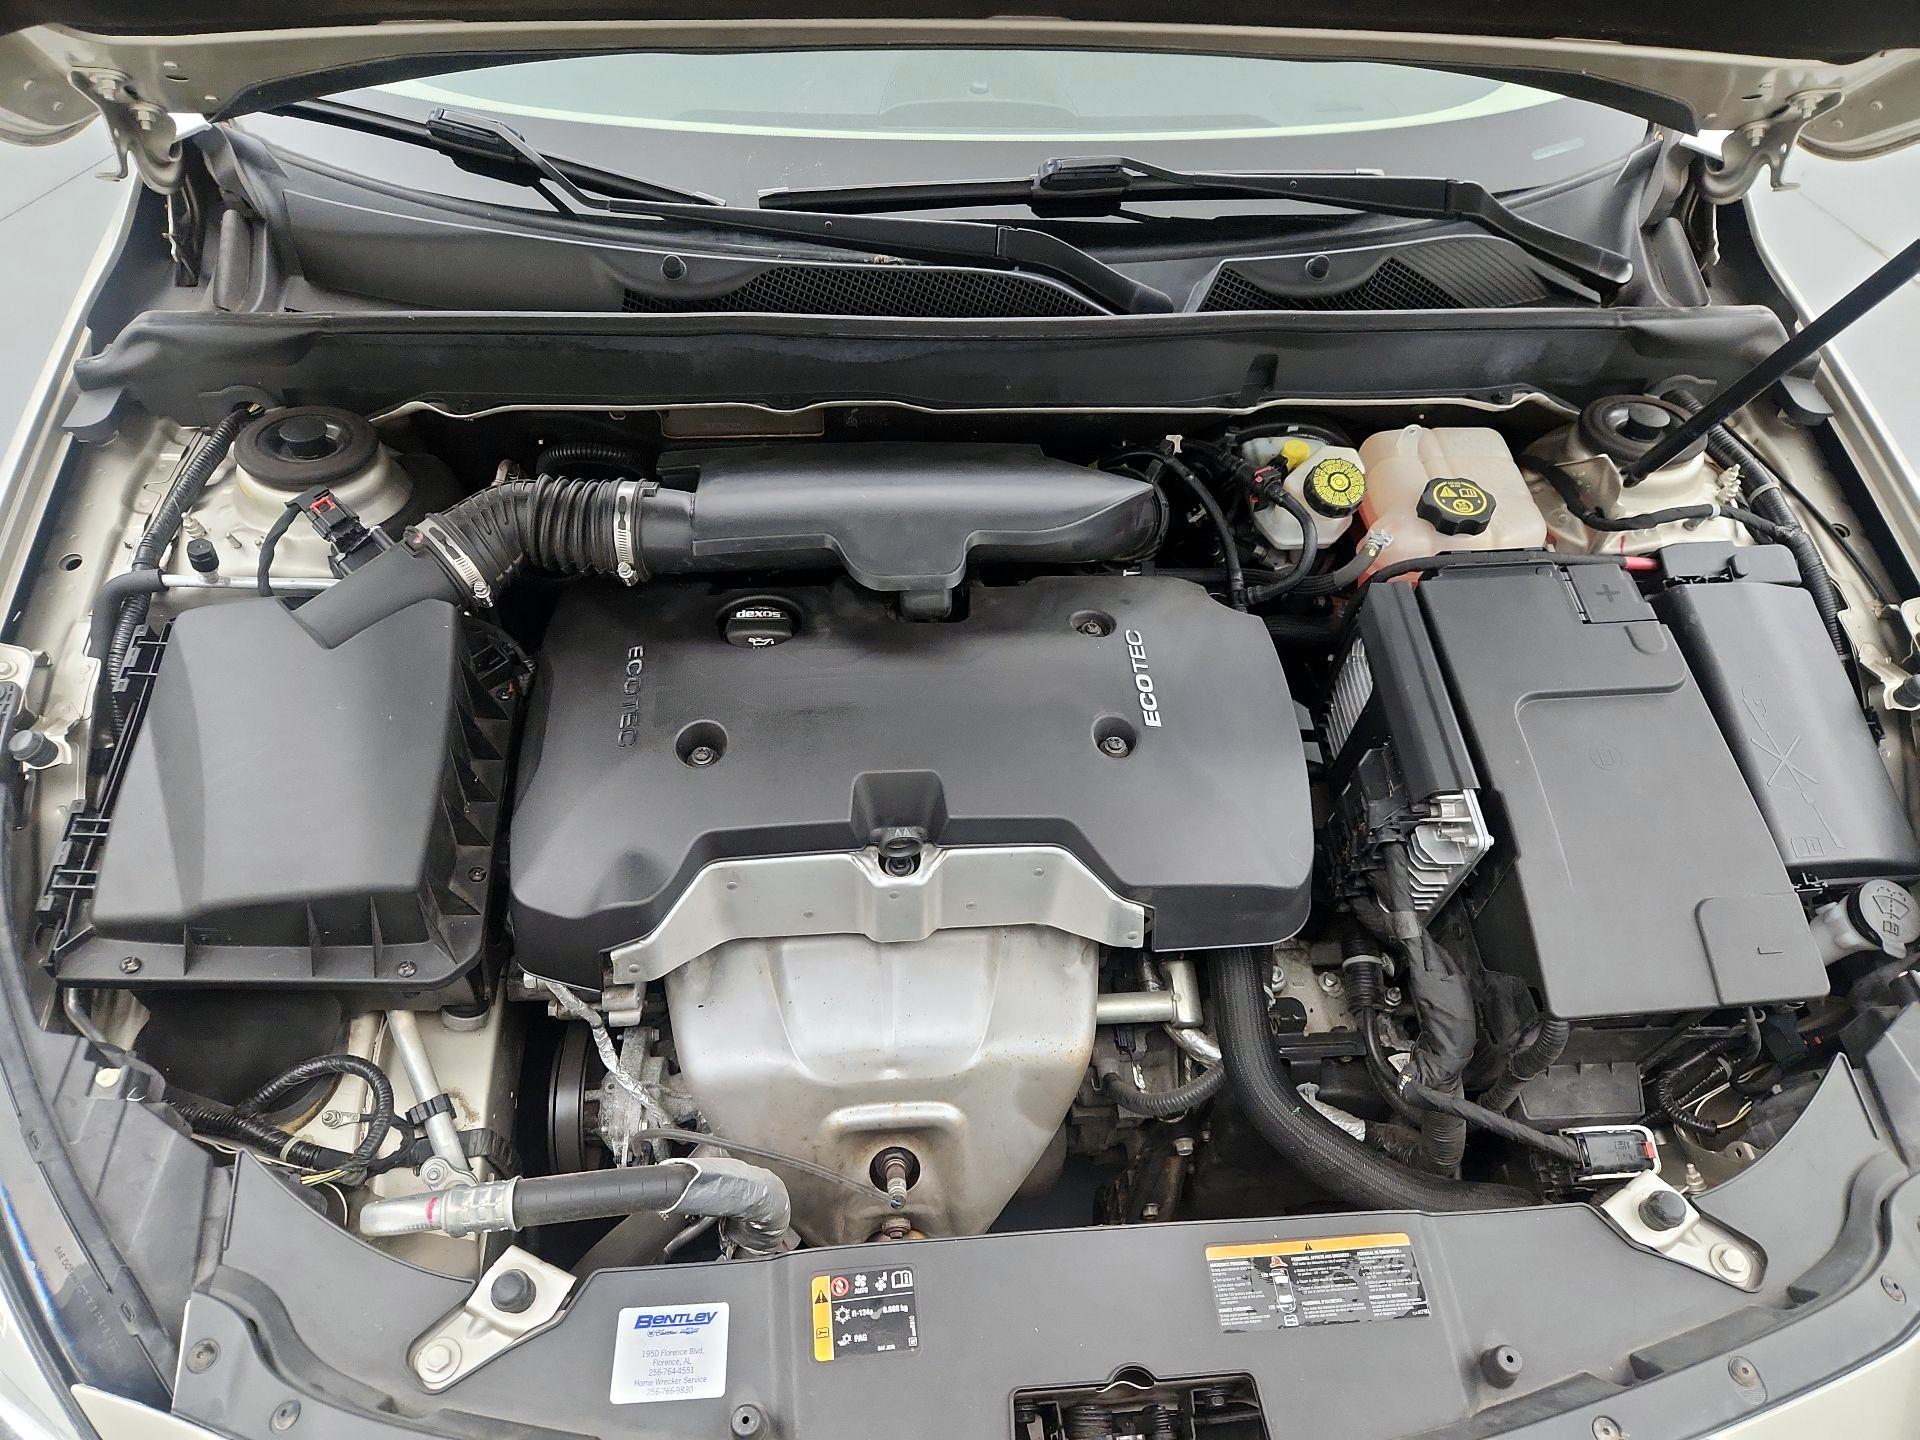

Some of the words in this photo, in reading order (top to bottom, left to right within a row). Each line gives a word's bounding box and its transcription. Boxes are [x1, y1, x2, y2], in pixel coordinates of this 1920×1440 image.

[736, 609, 781, 618] dexos
[1125, 629, 1161, 727] ECOTEC
[618, 645, 643, 748] ECOTEC
[660, 1348, 687, 1357] Florence
[684, 1375, 707, 1384] Service
